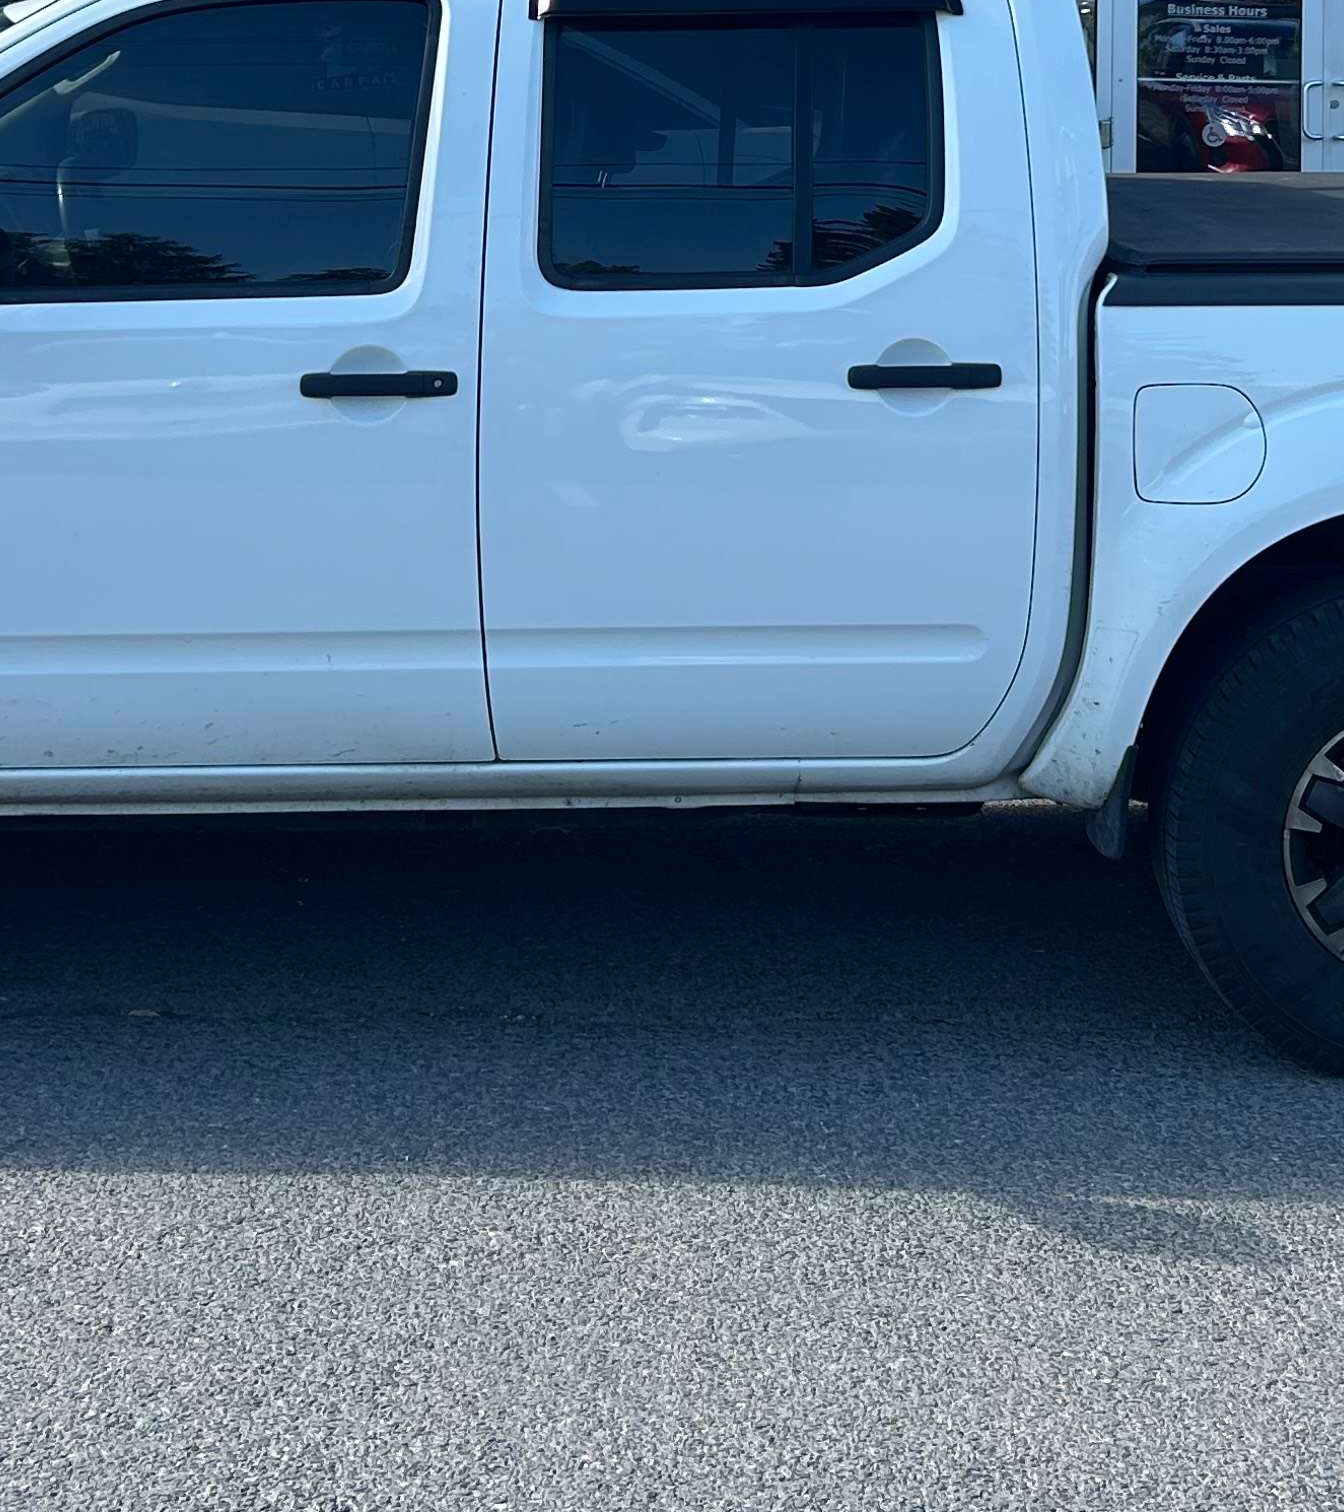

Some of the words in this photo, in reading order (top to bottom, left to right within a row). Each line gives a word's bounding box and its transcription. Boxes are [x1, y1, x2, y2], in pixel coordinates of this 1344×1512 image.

[1167, 3, 1225, 16] Business
[1229, 5, 1268, 17] Hours
[1203, 23, 1232, 34] Sales
